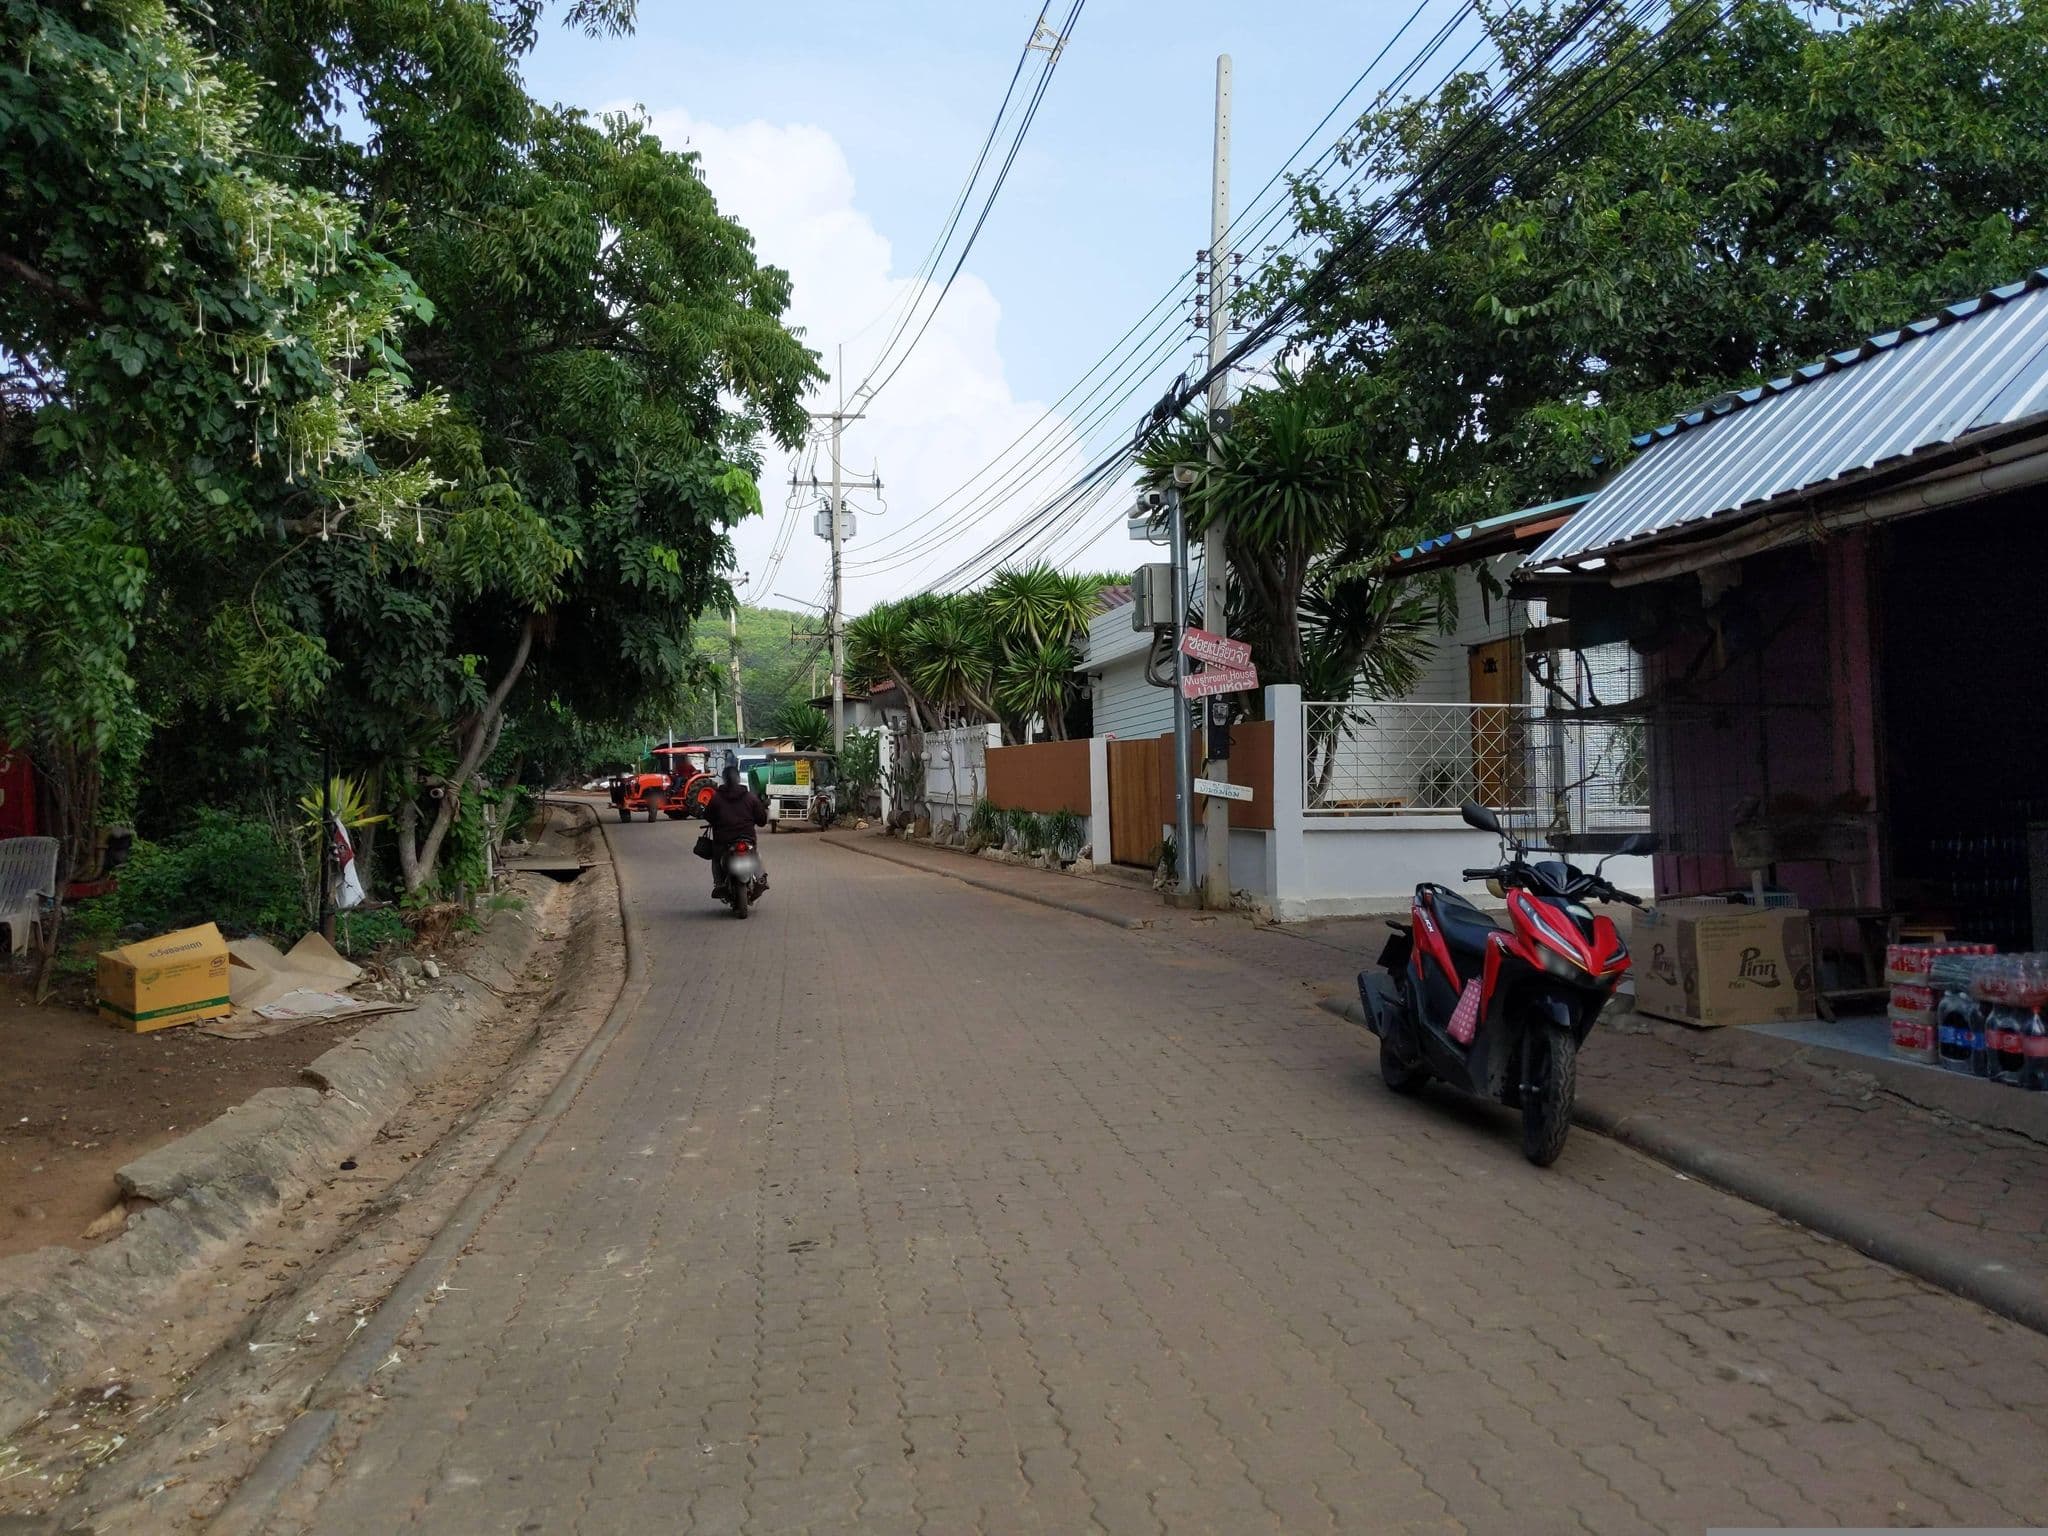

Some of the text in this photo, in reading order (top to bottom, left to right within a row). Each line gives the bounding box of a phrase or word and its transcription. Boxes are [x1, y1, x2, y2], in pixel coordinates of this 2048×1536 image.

[1184, 669, 1256, 686] Mushroom House
[1738, 947, 1777, 978] Pinn
